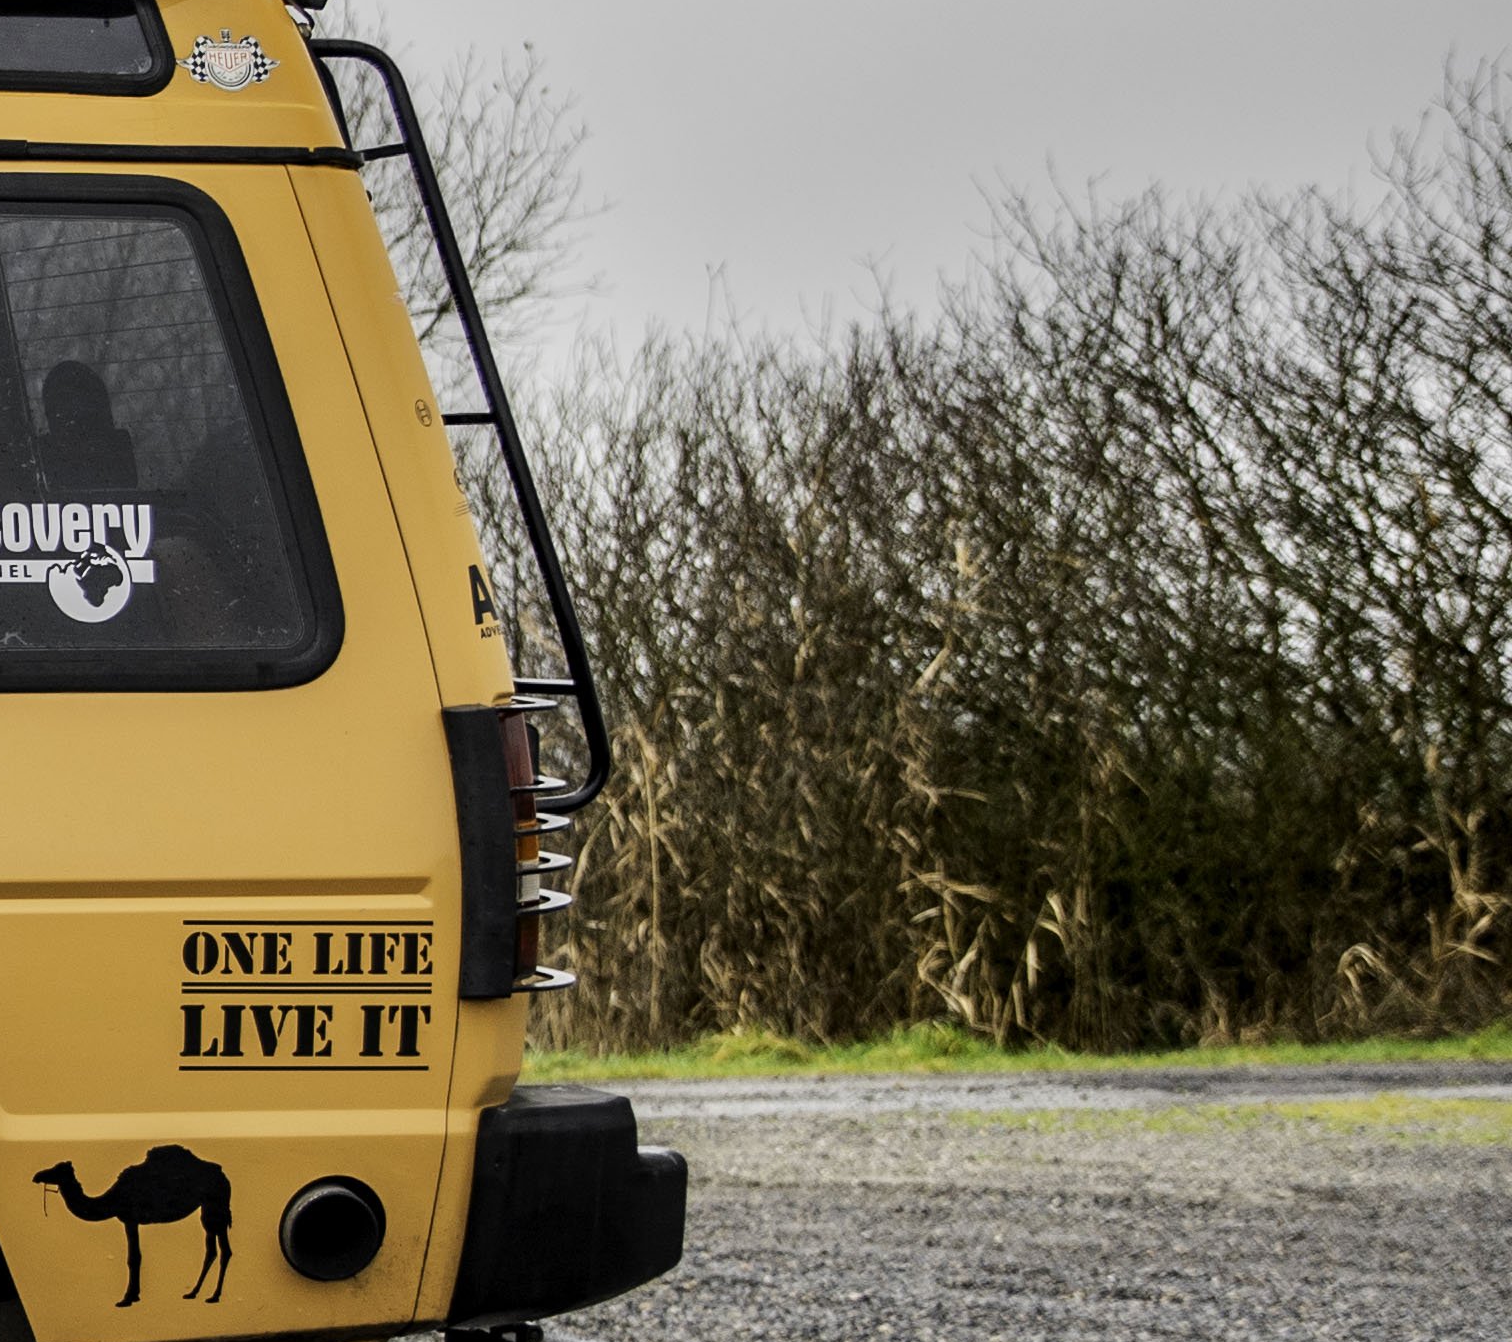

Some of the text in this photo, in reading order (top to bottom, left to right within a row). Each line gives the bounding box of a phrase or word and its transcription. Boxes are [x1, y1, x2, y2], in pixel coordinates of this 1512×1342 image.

[208, 52, 248, 70] HEUER
[182, 931, 434, 976] ONE LIFE
[179, 1003, 432, 1058] LIVE IT
